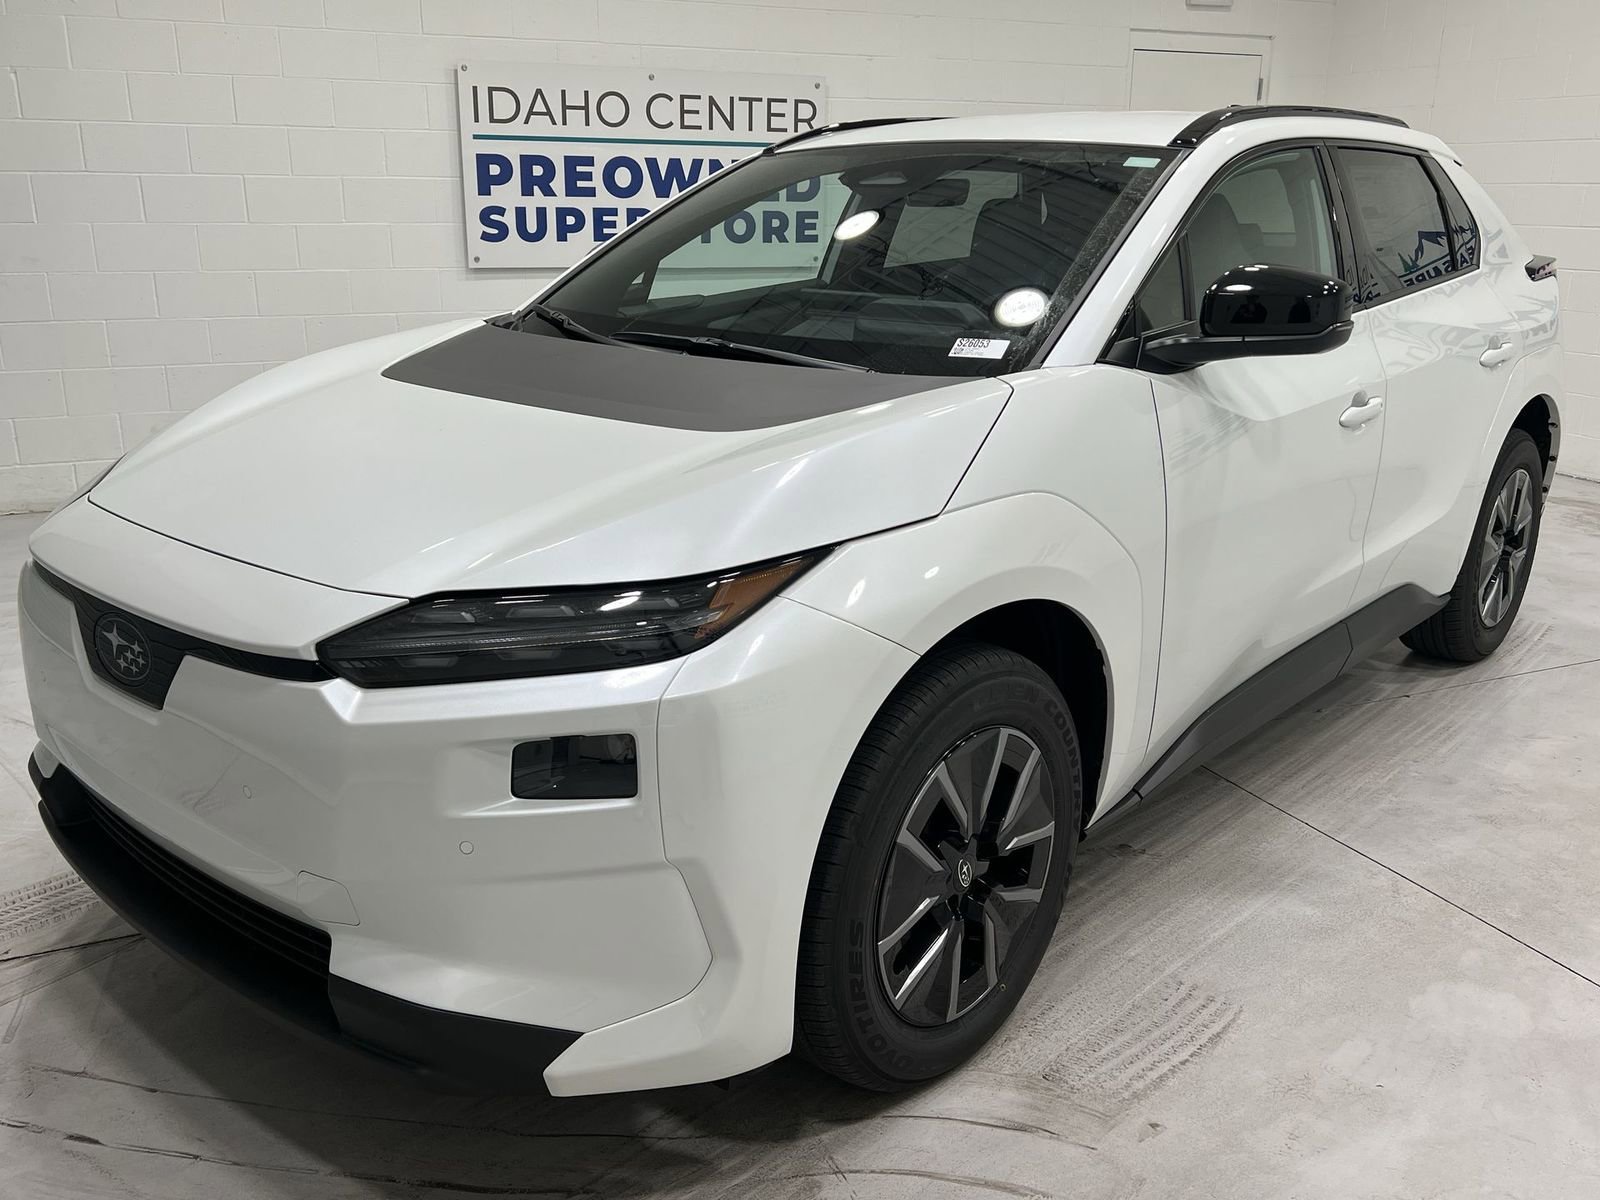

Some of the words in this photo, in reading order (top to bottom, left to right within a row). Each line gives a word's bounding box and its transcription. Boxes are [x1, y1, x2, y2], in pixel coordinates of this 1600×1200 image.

[472, 84, 630, 128] IDAHO
[645, 92, 818, 133] CENTER
[475, 152, 821, 204] PREOWD
[957, 338, 991, 348] S26053
[848, 918, 875, 1034] TIRES
